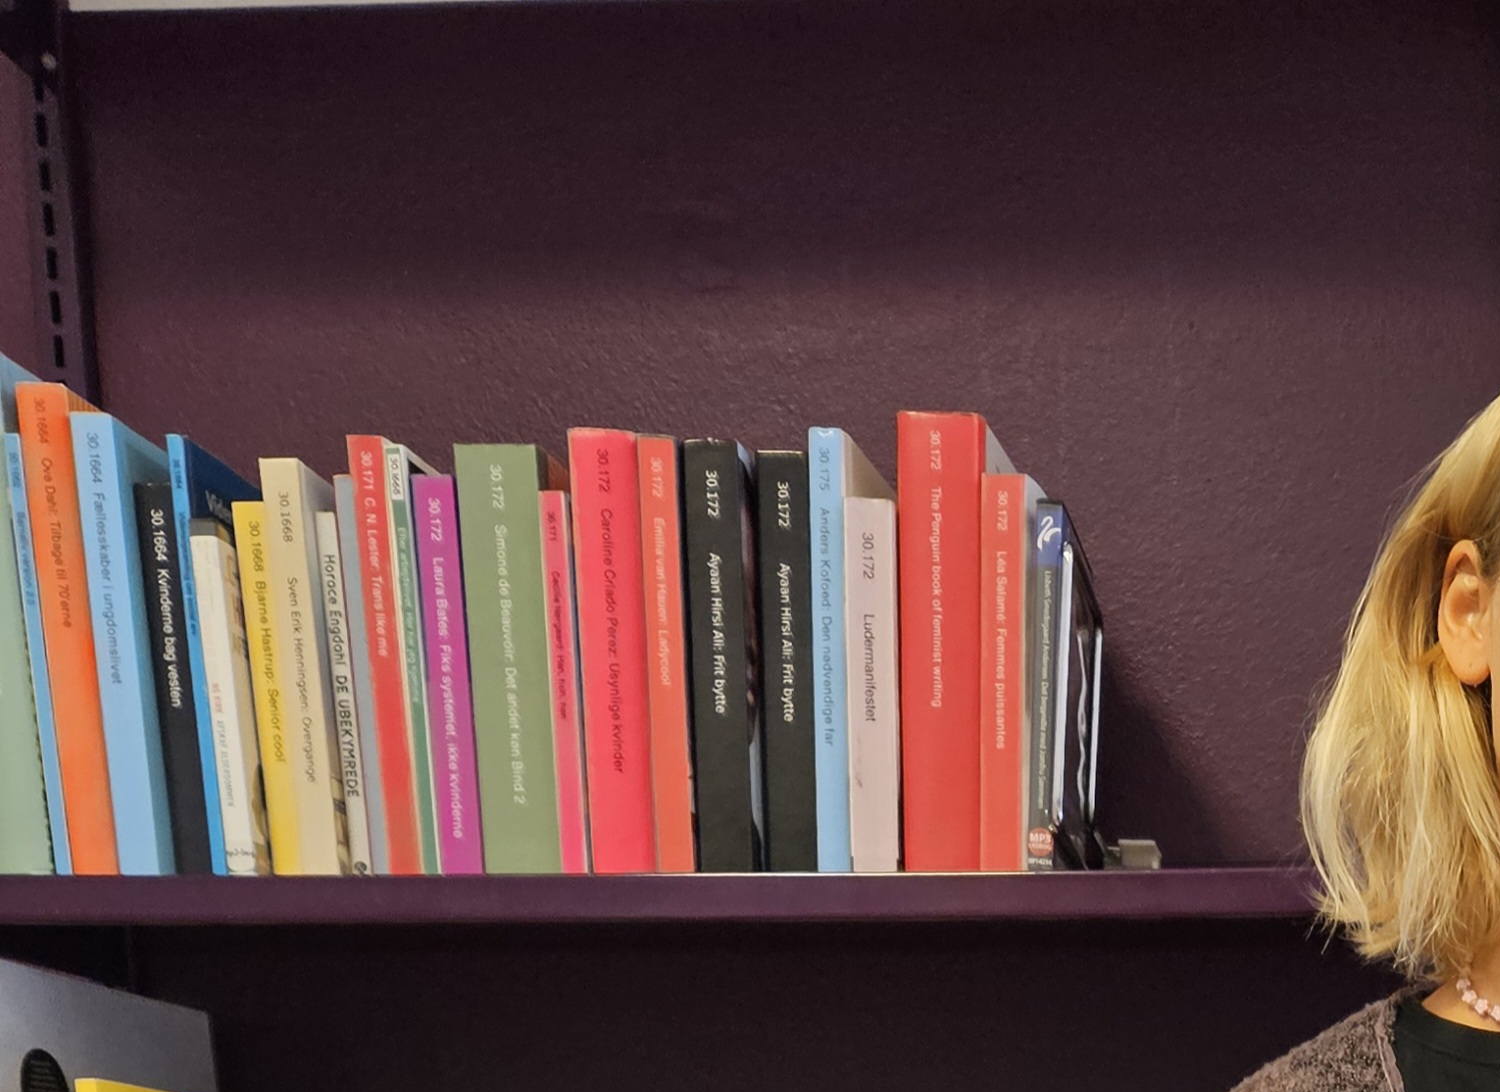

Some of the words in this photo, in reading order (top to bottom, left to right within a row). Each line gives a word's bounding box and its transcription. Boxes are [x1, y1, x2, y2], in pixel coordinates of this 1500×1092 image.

[85, 431, 104, 484] 30.1664
[777, 481, 790, 527] 30.172
[92, 492, 114, 582] Fællesskaber
[148, 508, 168, 562] 30.1664
[862, 532, 875, 580] 30.172
[156, 568, 176, 633] Kvinderne
[322, 554, 341, 605] Horace
[776, 563, 792, 602] Ayaan
[100, 592, 125, 684] ungdomslivet
[324, 609, 347, 665] Engdahl
[780, 607, 792, 635] Hirsi
[160, 636, 180, 661] bag
[863, 613, 877, 722] Ludermanifestet
[167, 664, 185, 707] vesten
[334, 675, 350, 694] DE
[781, 664, 794, 685] Frit
[779, 687, 795, 722] bytte
[337, 700, 360, 798] UBEKYMREDE
